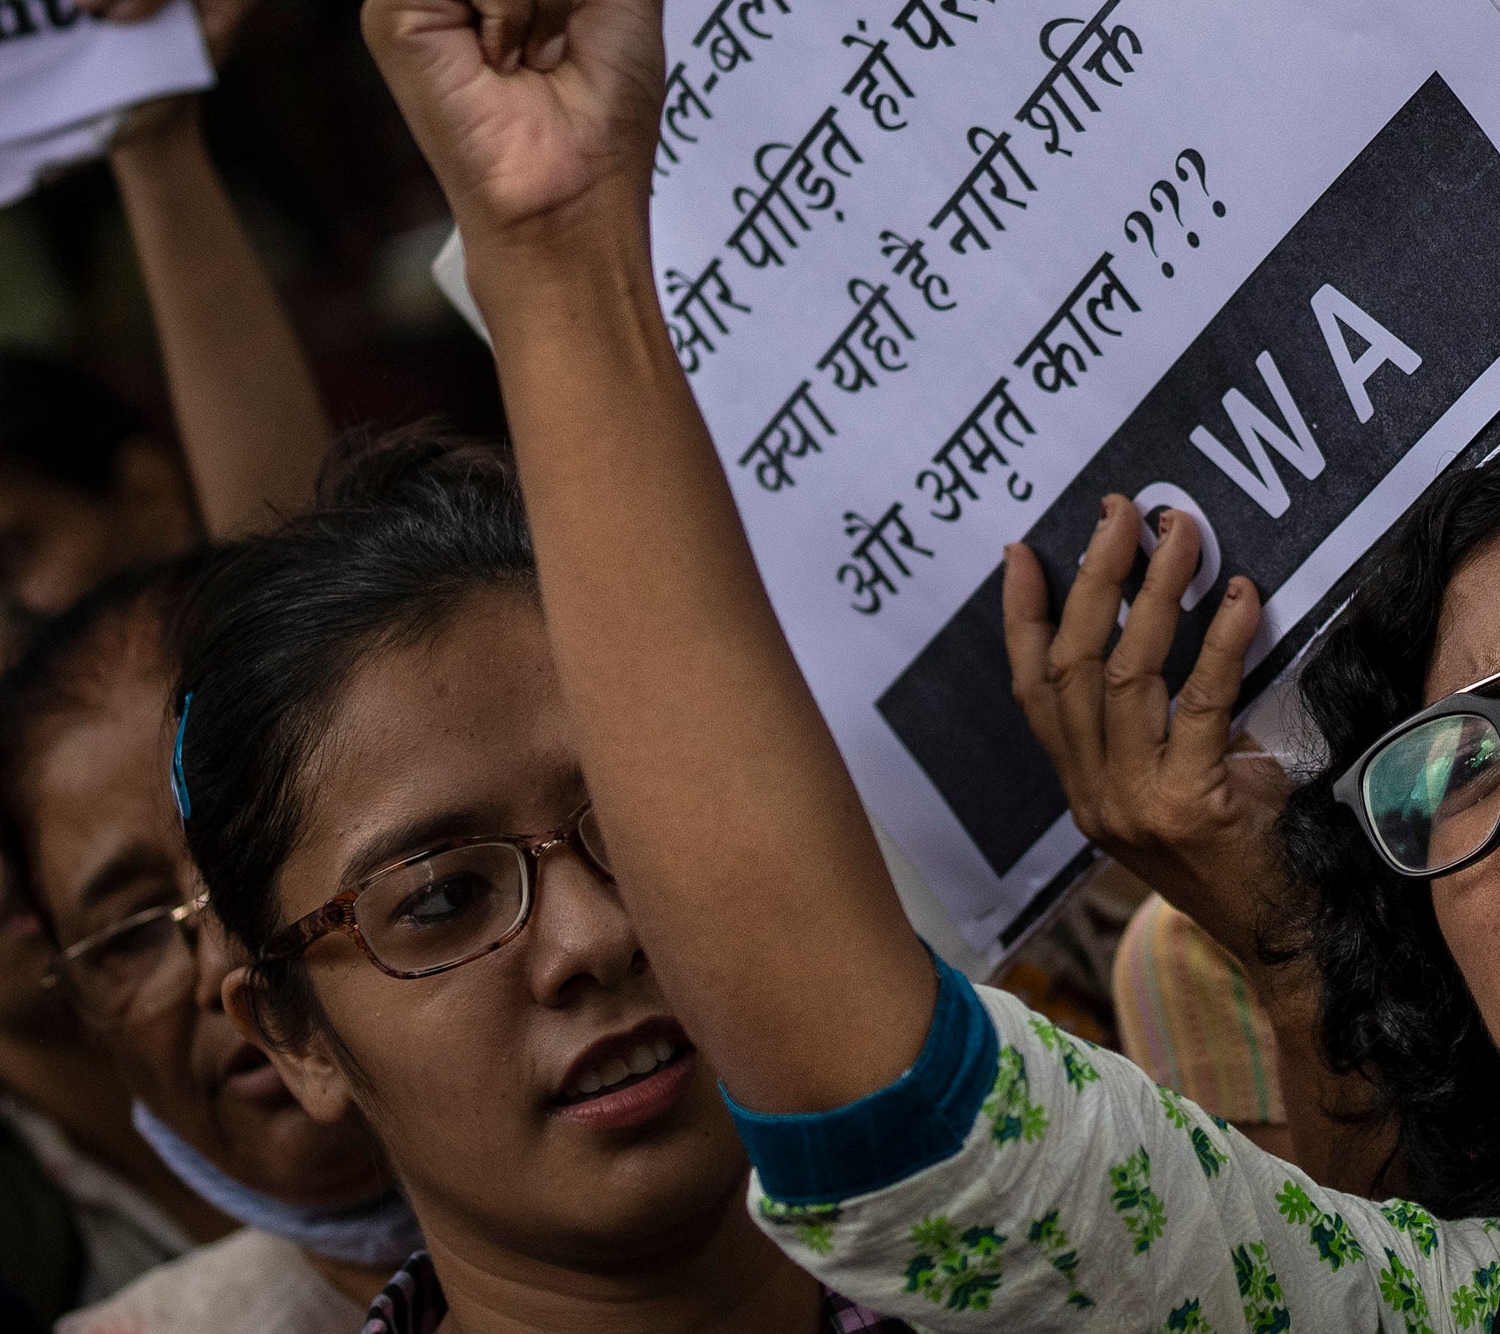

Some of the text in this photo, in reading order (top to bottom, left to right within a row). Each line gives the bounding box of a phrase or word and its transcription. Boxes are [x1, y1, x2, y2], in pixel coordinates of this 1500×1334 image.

[726, 106, 863, 271] पीड़ित
[842, 20, 915, 131] हों
[738, 380, 836, 492] क्या
[816, 278, 915, 393] यही
[879, 230, 957, 311] है
[929, 127, 1037, 254] नारी
[837, 148, 1226, 615] और अमृत काल ???
